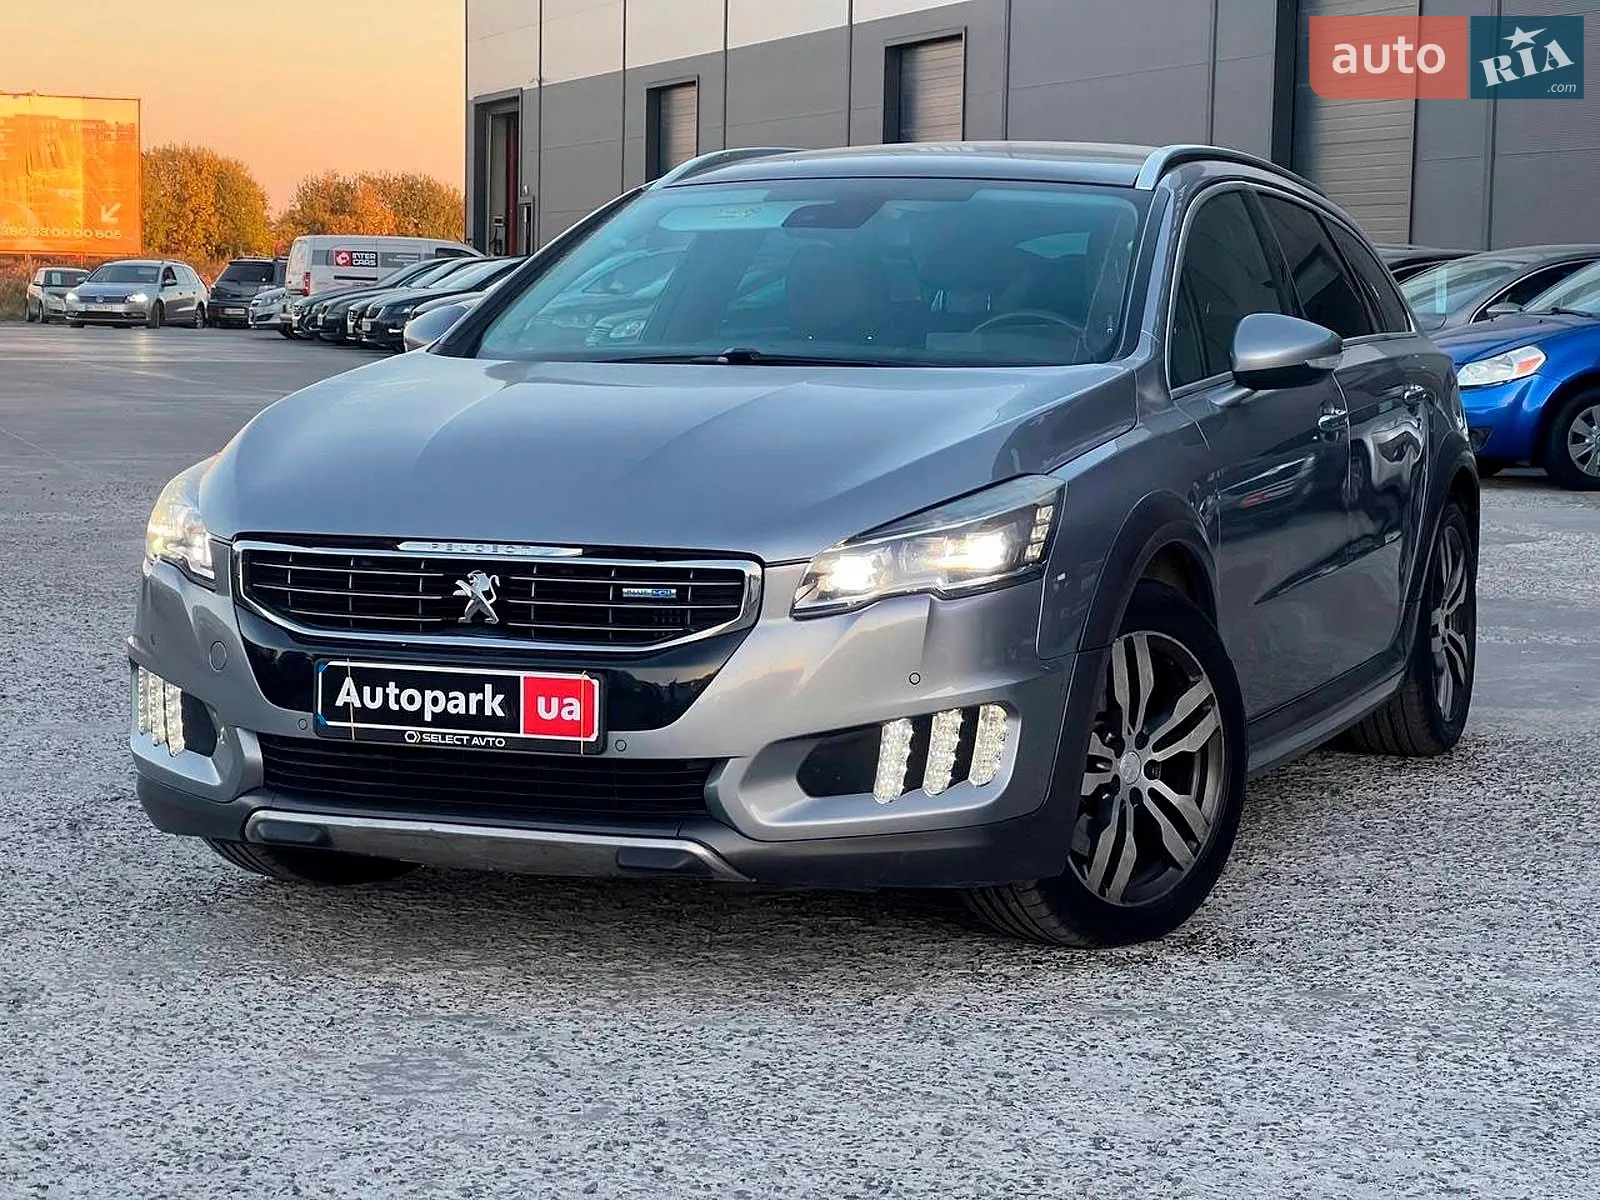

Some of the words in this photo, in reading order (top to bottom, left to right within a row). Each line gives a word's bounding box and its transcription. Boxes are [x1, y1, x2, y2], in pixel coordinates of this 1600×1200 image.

[335, 676, 505, 722] Autopark
[537, 696, 582, 721] ua
[422, 733, 471, 745] SELECT
[471, 737, 505, 747] AVTO
